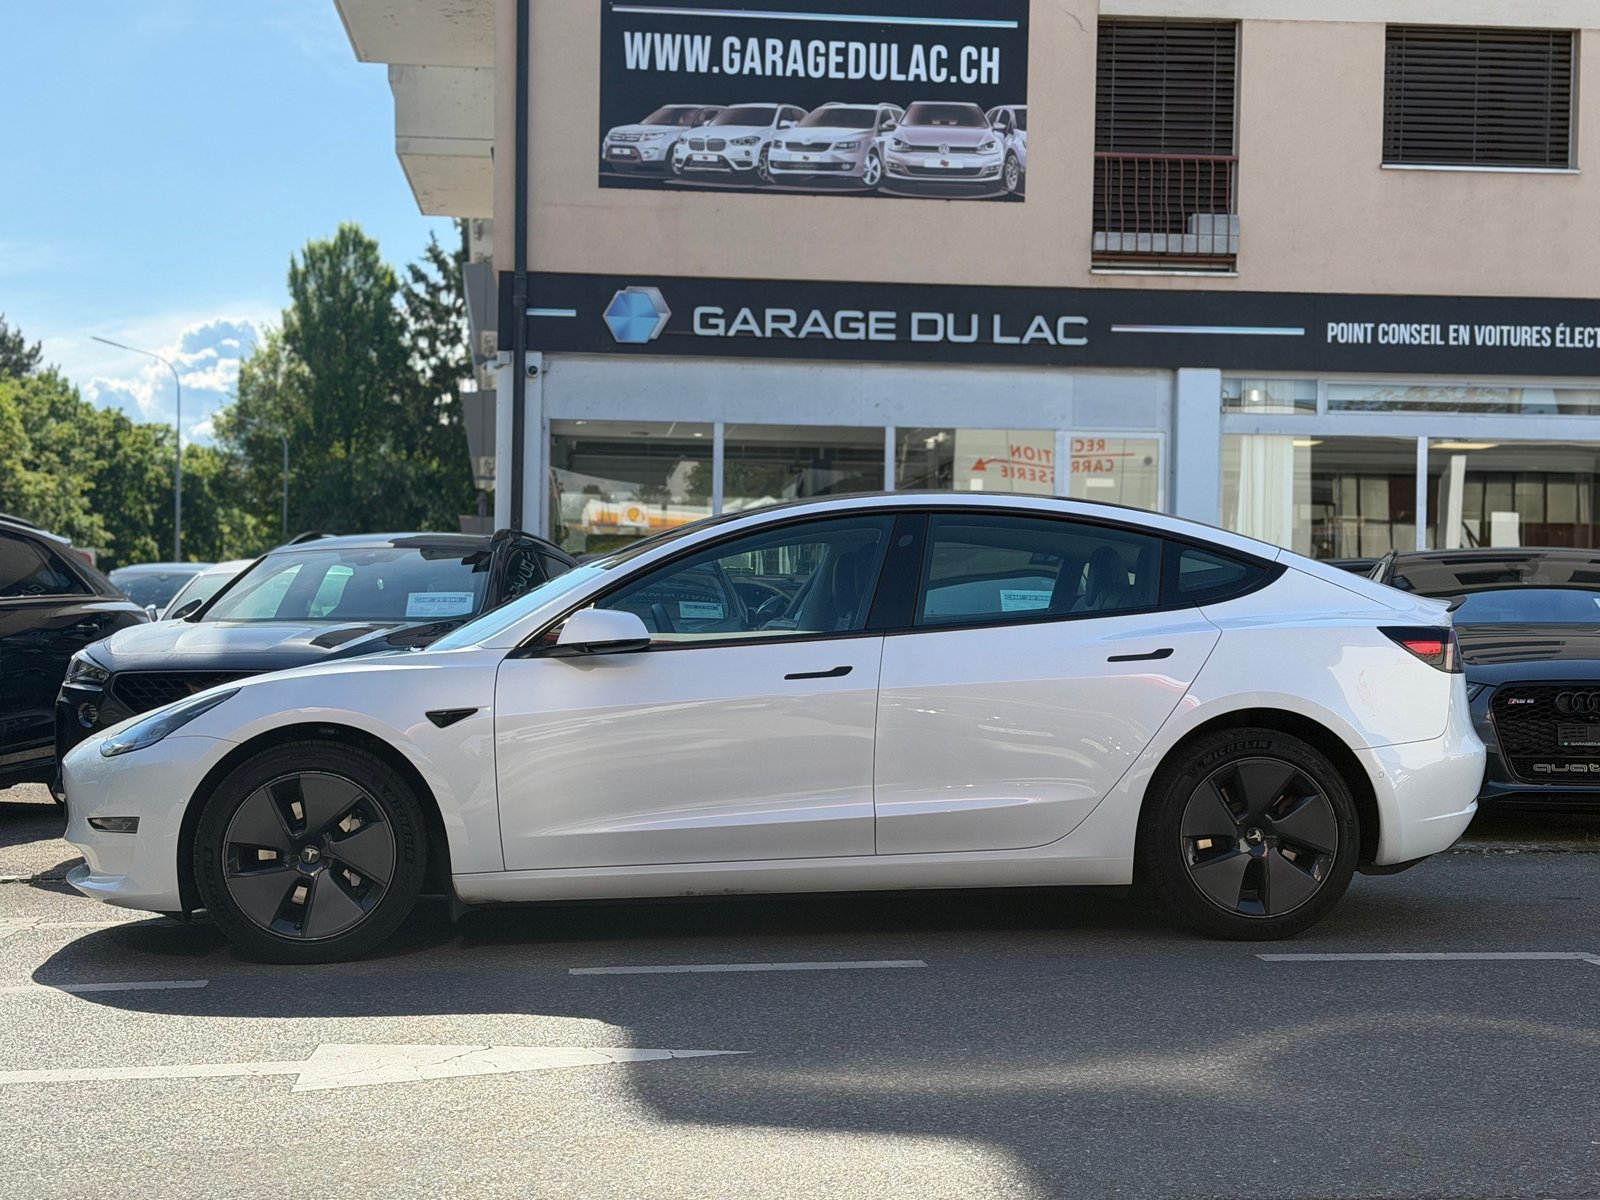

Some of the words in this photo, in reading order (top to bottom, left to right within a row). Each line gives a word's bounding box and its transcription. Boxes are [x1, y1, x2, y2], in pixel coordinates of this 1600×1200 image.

[623, 31, 1000, 84] WWW.GARAGEDULAC.CH
[693, 306, 896, 340] GARAGE
[911, 312, 978, 342] DU
[993, 314, 1088, 345] LAC
[1327, 322, 1374, 343] POINT
[1378, 323, 1445, 345] CONSEIL
[1449, 324, 1470, 346] EN
[1474, 325, 1552, 347] VOITURES
[1555, 322, 1600, 348] ÉLECT
[1533, 763, 1600, 774] quat
